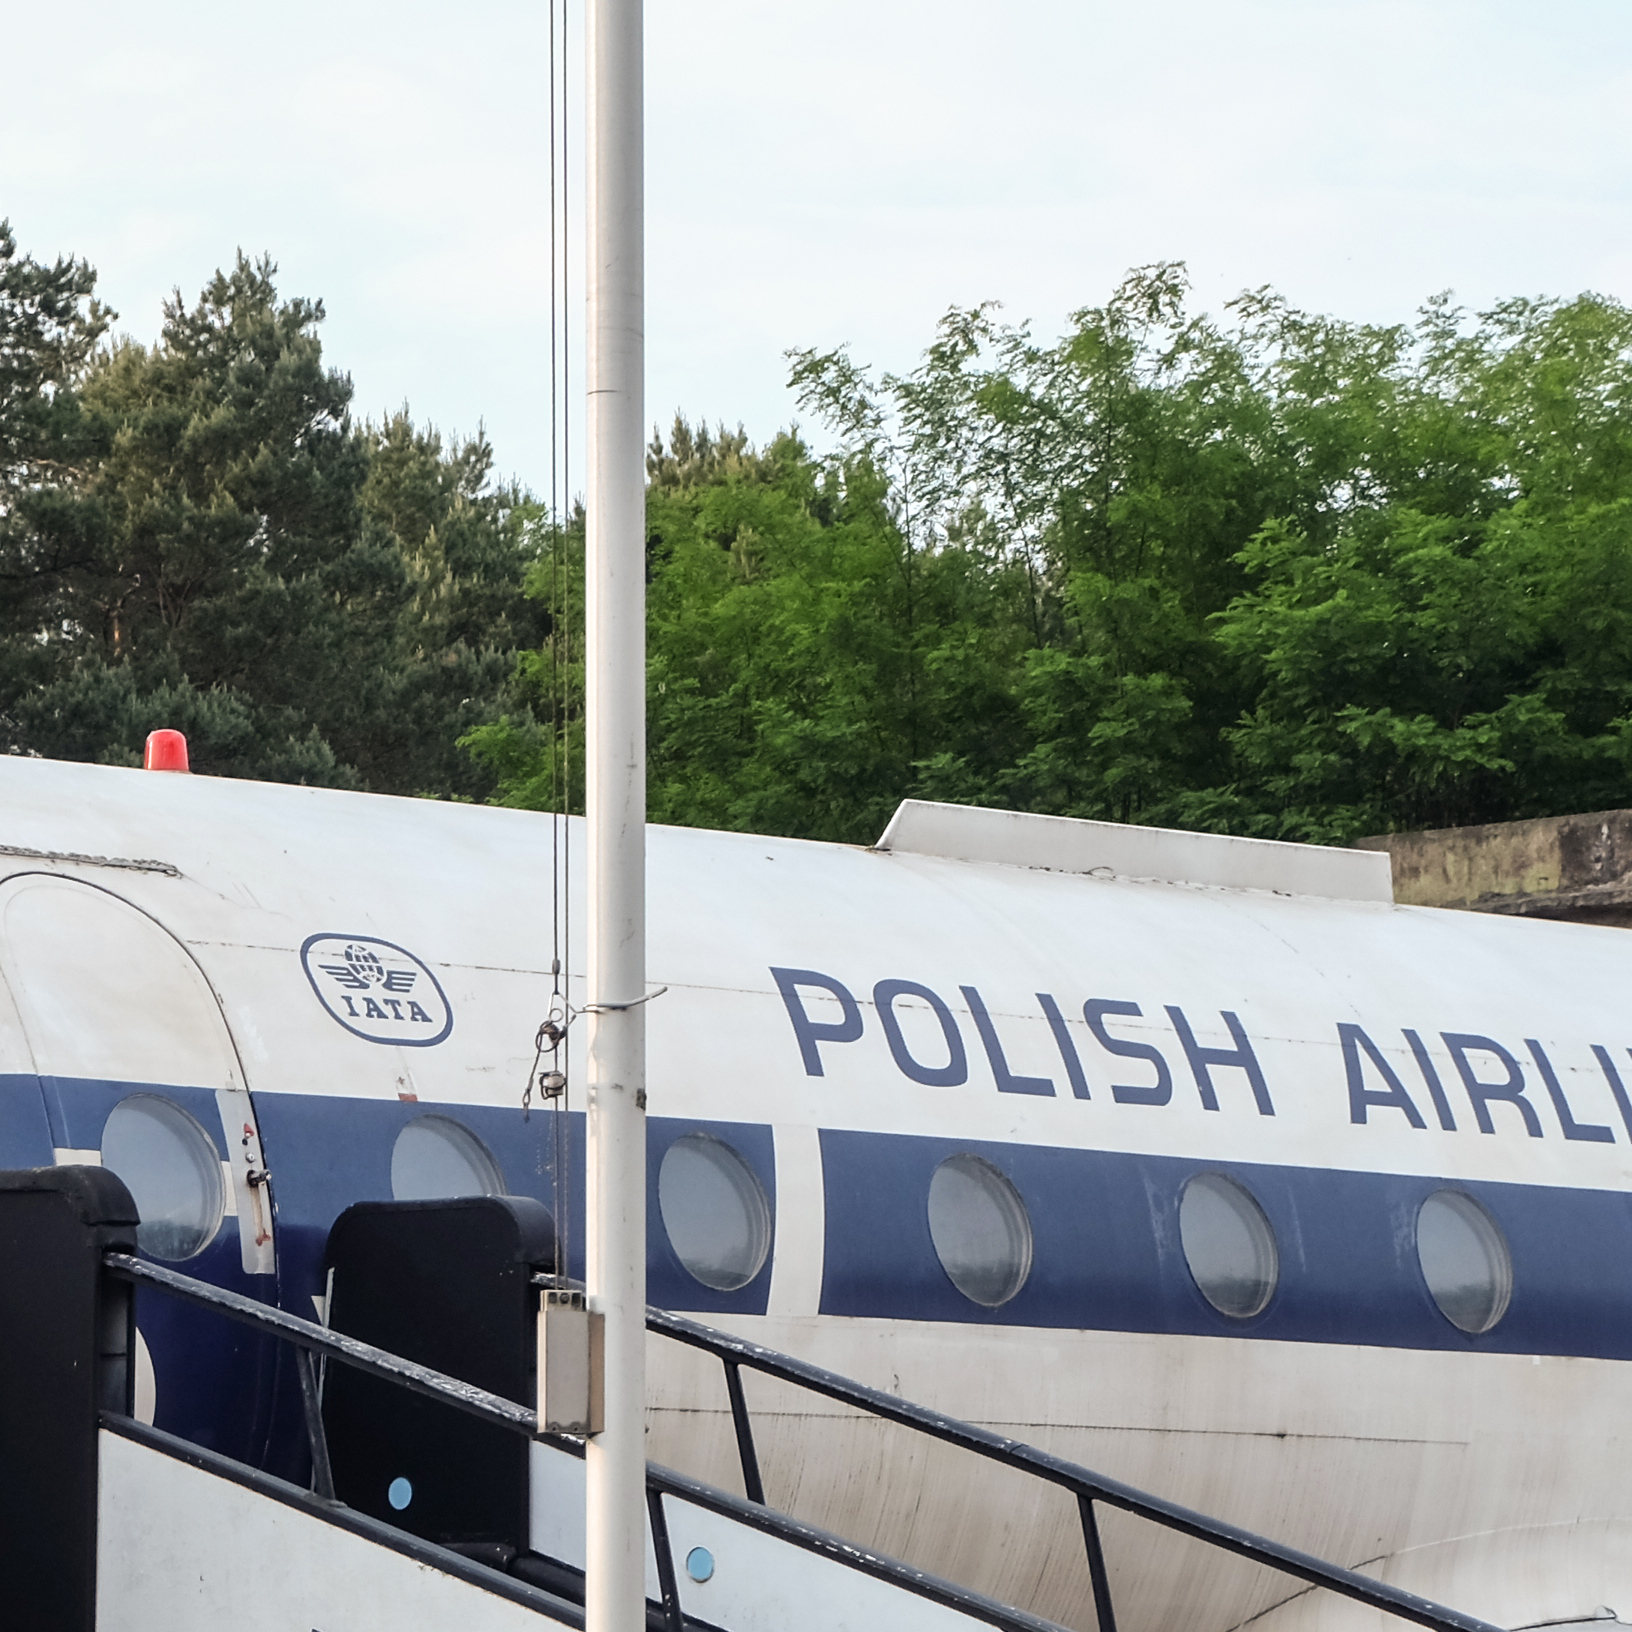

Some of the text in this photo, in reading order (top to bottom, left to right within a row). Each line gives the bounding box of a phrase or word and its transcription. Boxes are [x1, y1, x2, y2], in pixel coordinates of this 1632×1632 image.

[340, 994, 433, 1022] IATA
[769, 966, 1632, 1144] POLISH AIRLI
